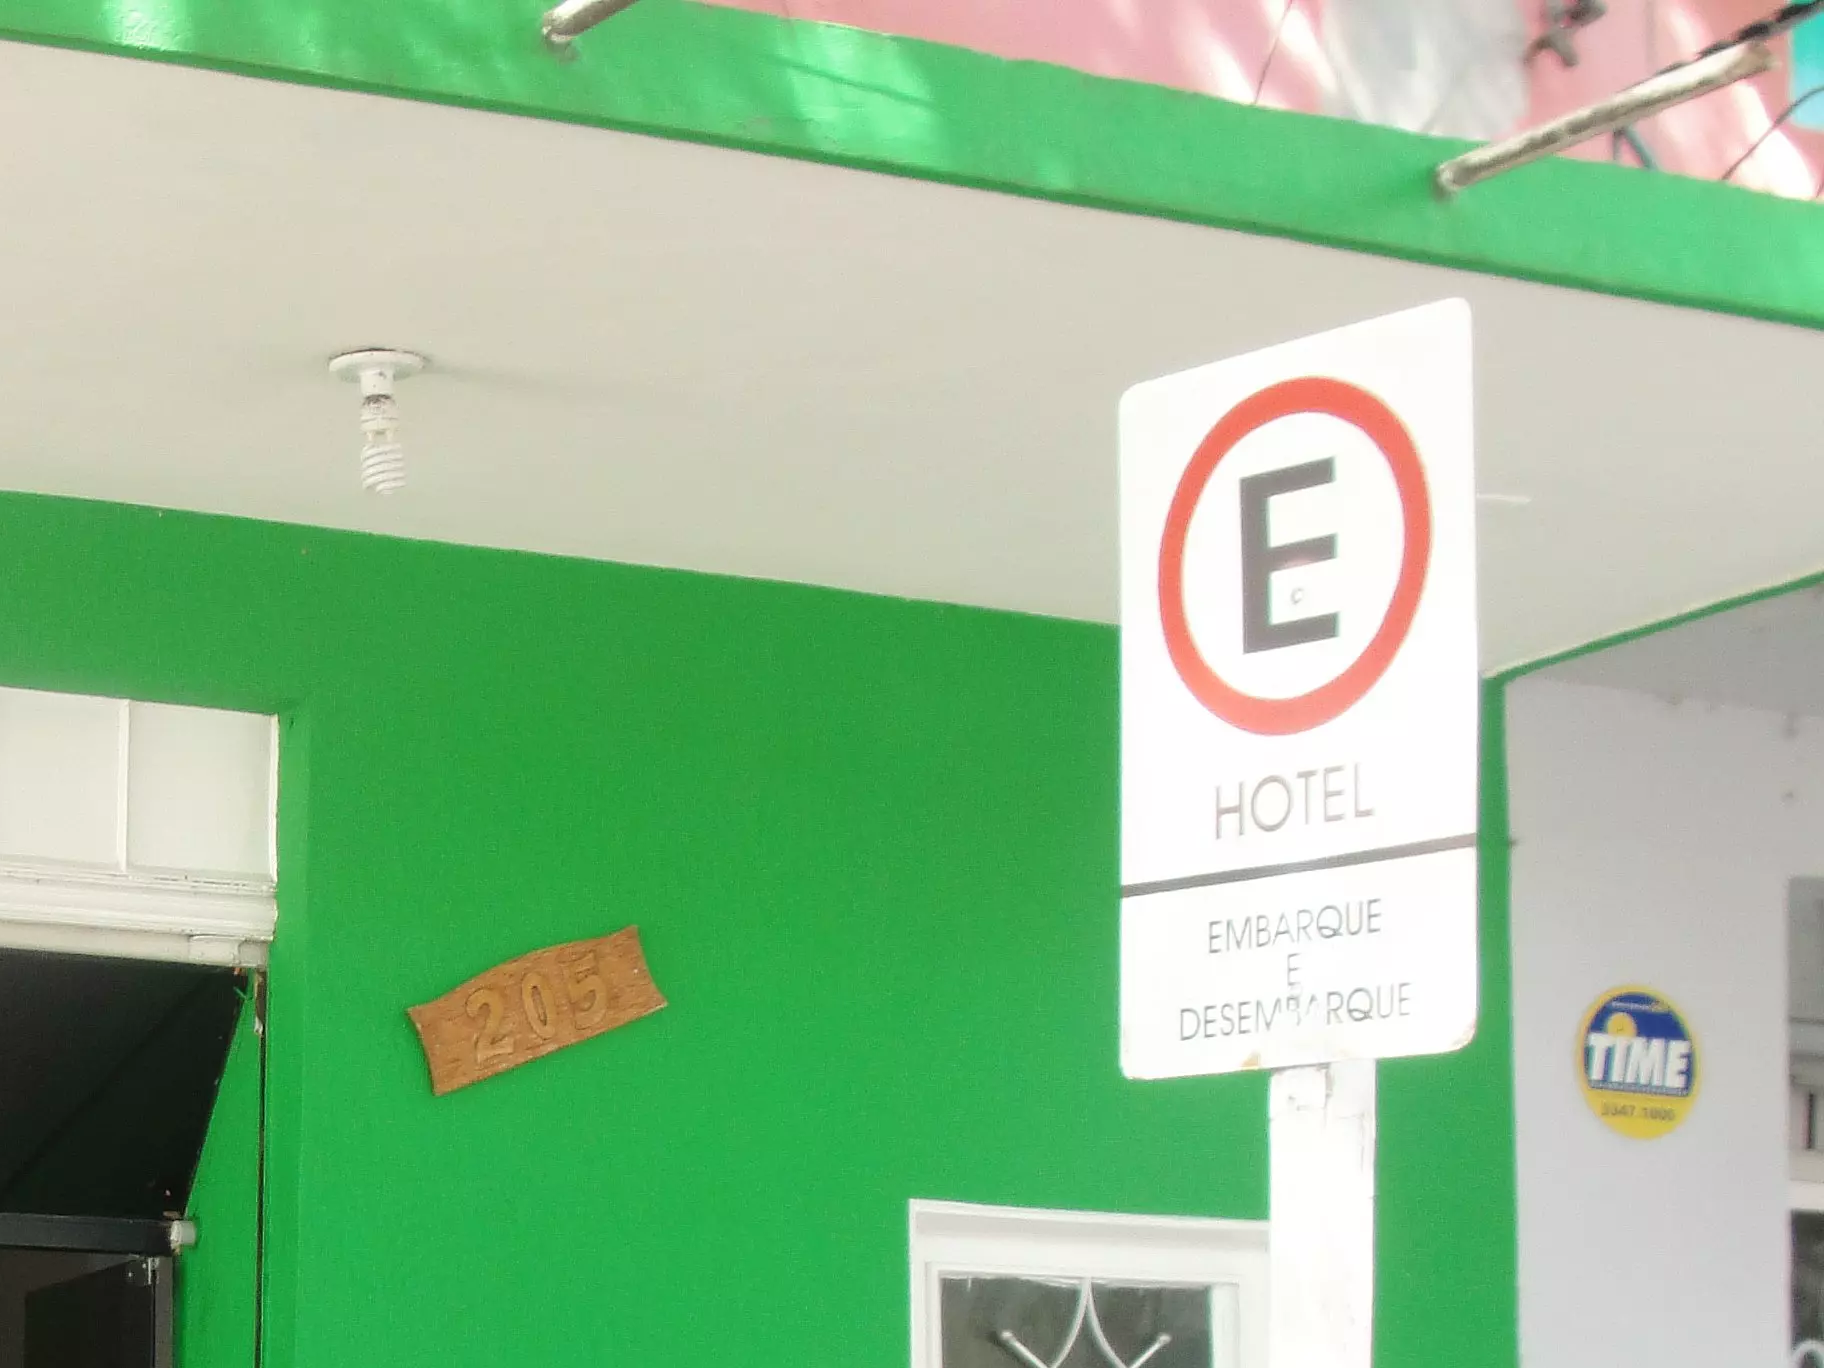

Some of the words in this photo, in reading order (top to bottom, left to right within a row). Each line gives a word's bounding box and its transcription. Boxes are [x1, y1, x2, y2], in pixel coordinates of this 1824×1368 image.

[1239, 456, 1339, 654] E
[1214, 764, 1375, 841] HOTEL
[1208, 898, 1382, 954] EMBARQUE
[1287, 953, 1301, 986] E
[465, 949, 608, 1065] 205
[1587, 1031, 1693, 1089] TIME
